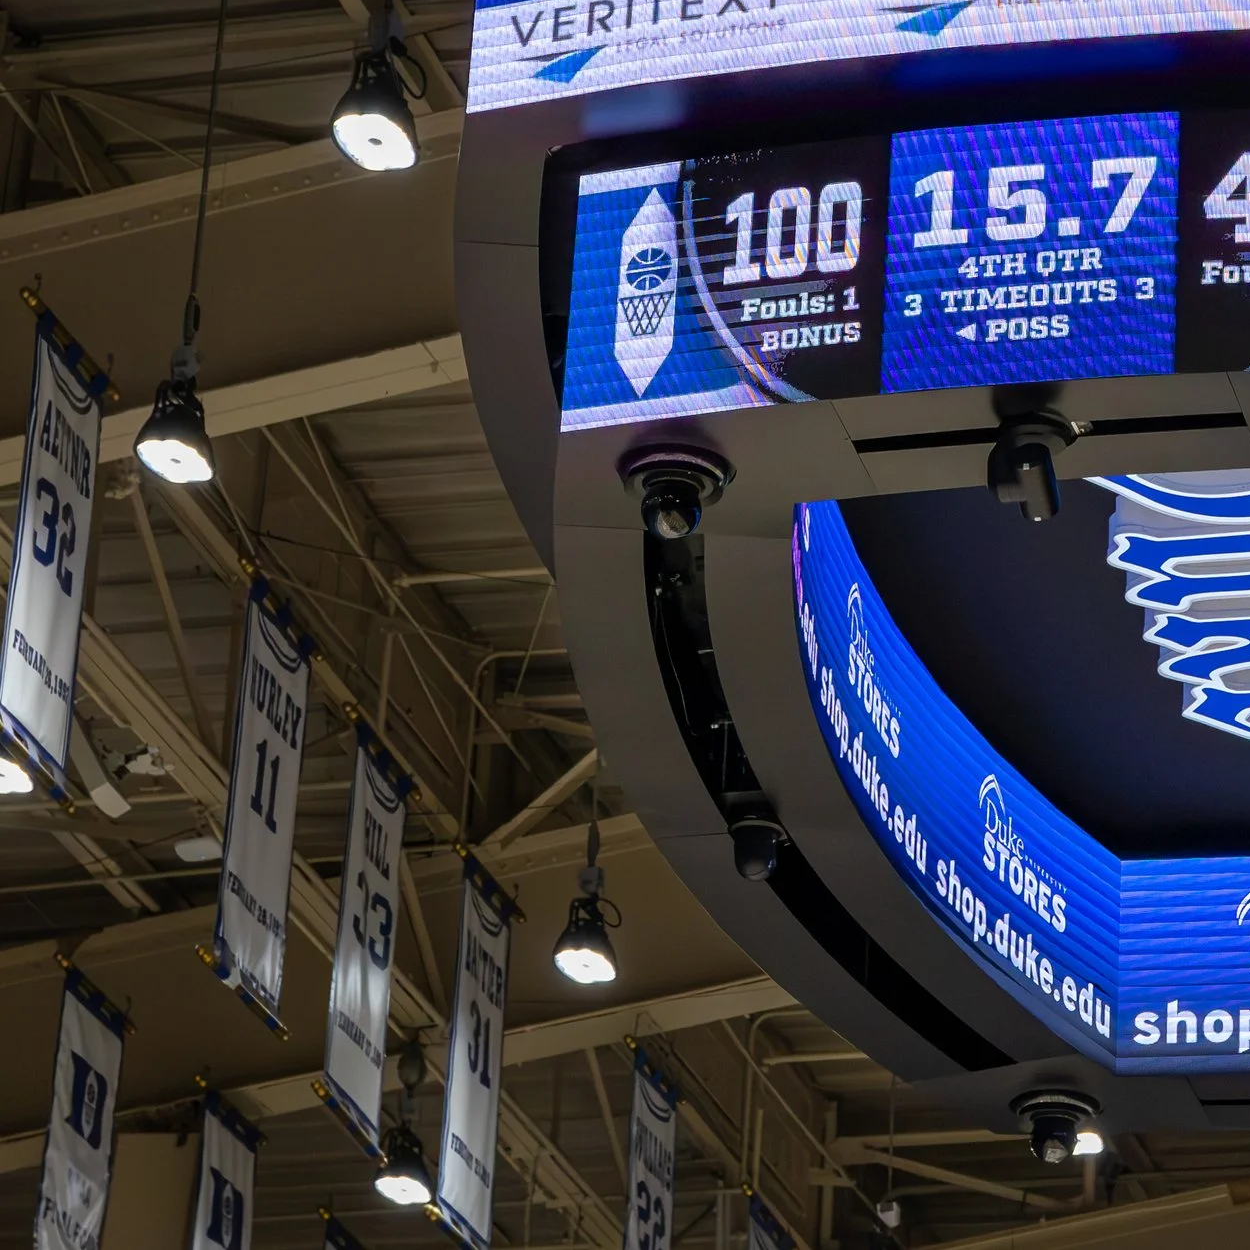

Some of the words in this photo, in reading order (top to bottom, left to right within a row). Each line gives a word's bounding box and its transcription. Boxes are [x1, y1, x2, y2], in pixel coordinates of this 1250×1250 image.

[723, 181, 862, 285] 100
[913, 156, 1158, 248] 15.7
[741, 292, 834, 322] Fouls:
[843, 287, 860, 311] 1
[904, 295, 923, 317] 3
[941, 280, 1118, 313] TIMEOUTS
[1135, 277, 1154, 300] 3
[958, 251, 1026, 280] 4TH
[1035, 248, 1102, 279] QTR
[761, 325, 862, 352] BONUS
[985, 314, 1069, 343] POSS
[33, 478, 76, 597] 32
[250, 654, 302, 750] HURLEY
[848, 642, 900, 758] STORES
[250, 739, 280, 834] 11
[820, 664, 927, 874] shop.duke.edu
[985, 796, 1024, 860] Duke
[983, 831, 1066, 933] STORES
[935, 858, 1111, 1039] shop.duke.edu
